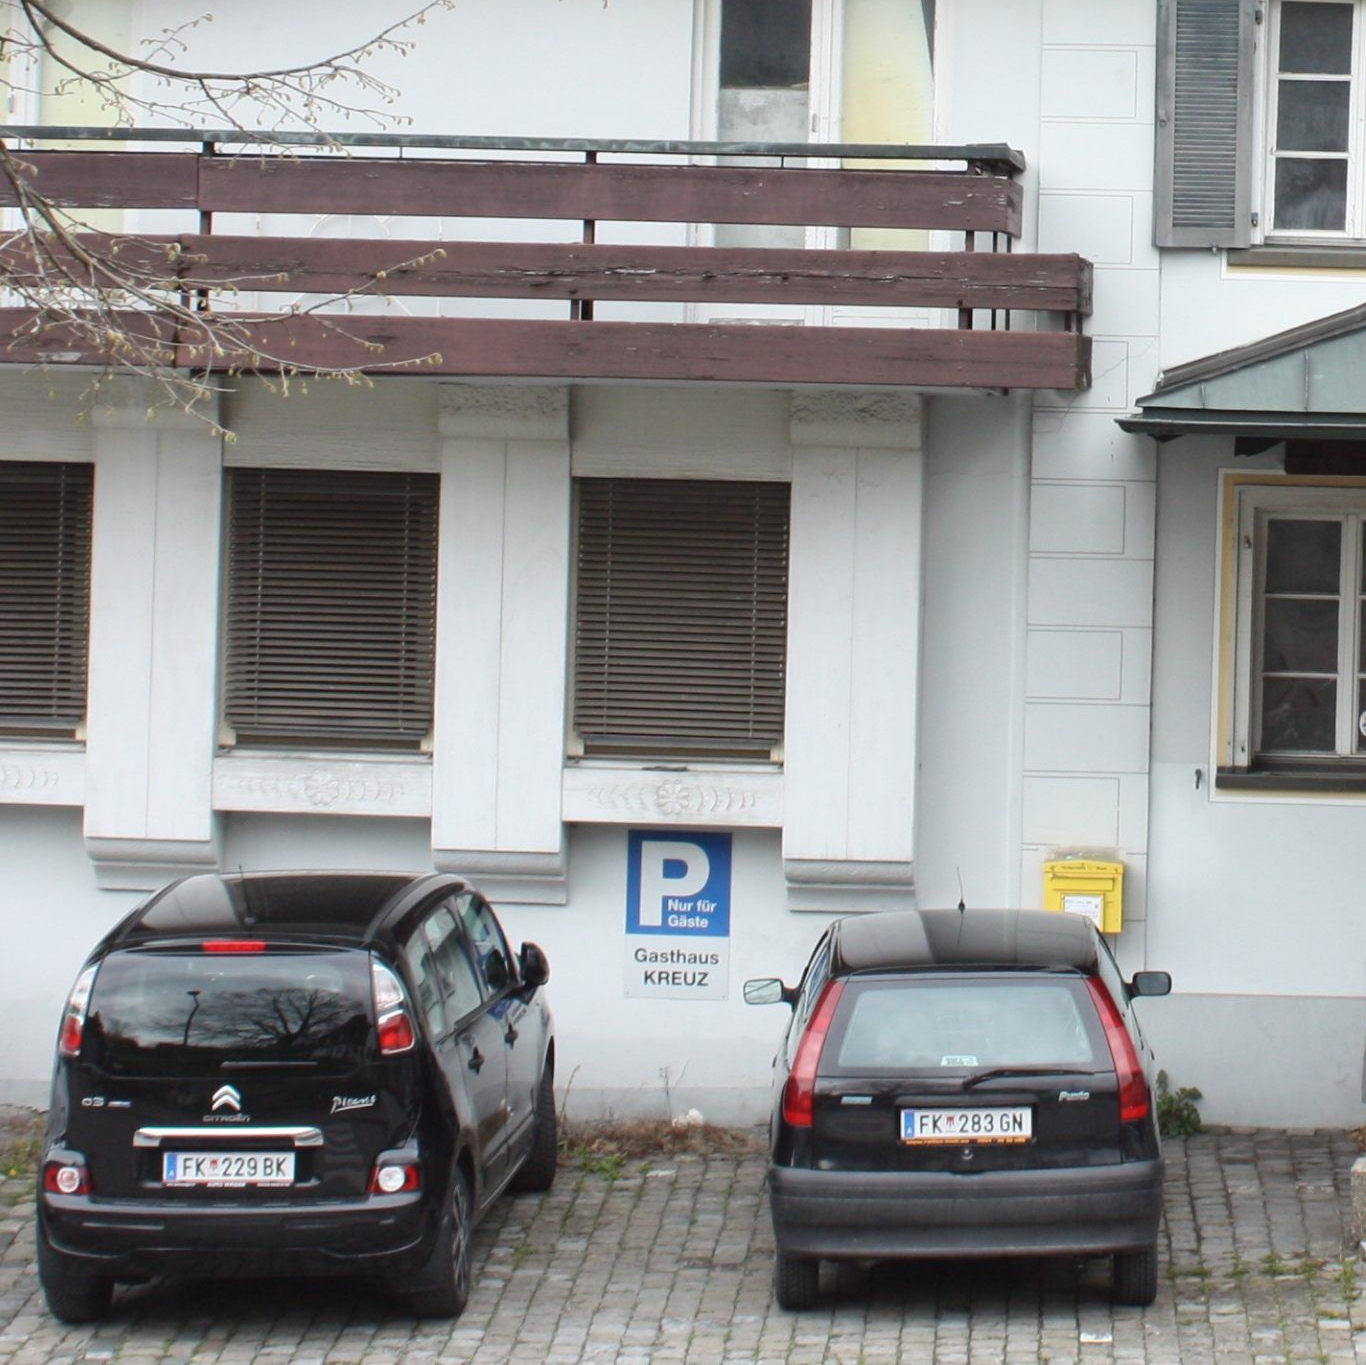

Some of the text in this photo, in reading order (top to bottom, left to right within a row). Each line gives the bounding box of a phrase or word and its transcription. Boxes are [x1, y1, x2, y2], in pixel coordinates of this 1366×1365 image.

[639, 841, 710, 927] P
[668, 899, 717, 913] Nur für
[668, 914, 709, 928] Gäste
[634, 948, 719, 965] Gasthaus
[644, 971, 709, 987] KREUZ
[919, 1114, 942, 1134] FK
[958, 1113, 994, 1133] 283
[1000, 1113, 1023, 1132] GN
[183, 1157, 206, 1177] FK
[221, 1157, 258, 1177] 229
[263, 1157, 288, 1177] BK
